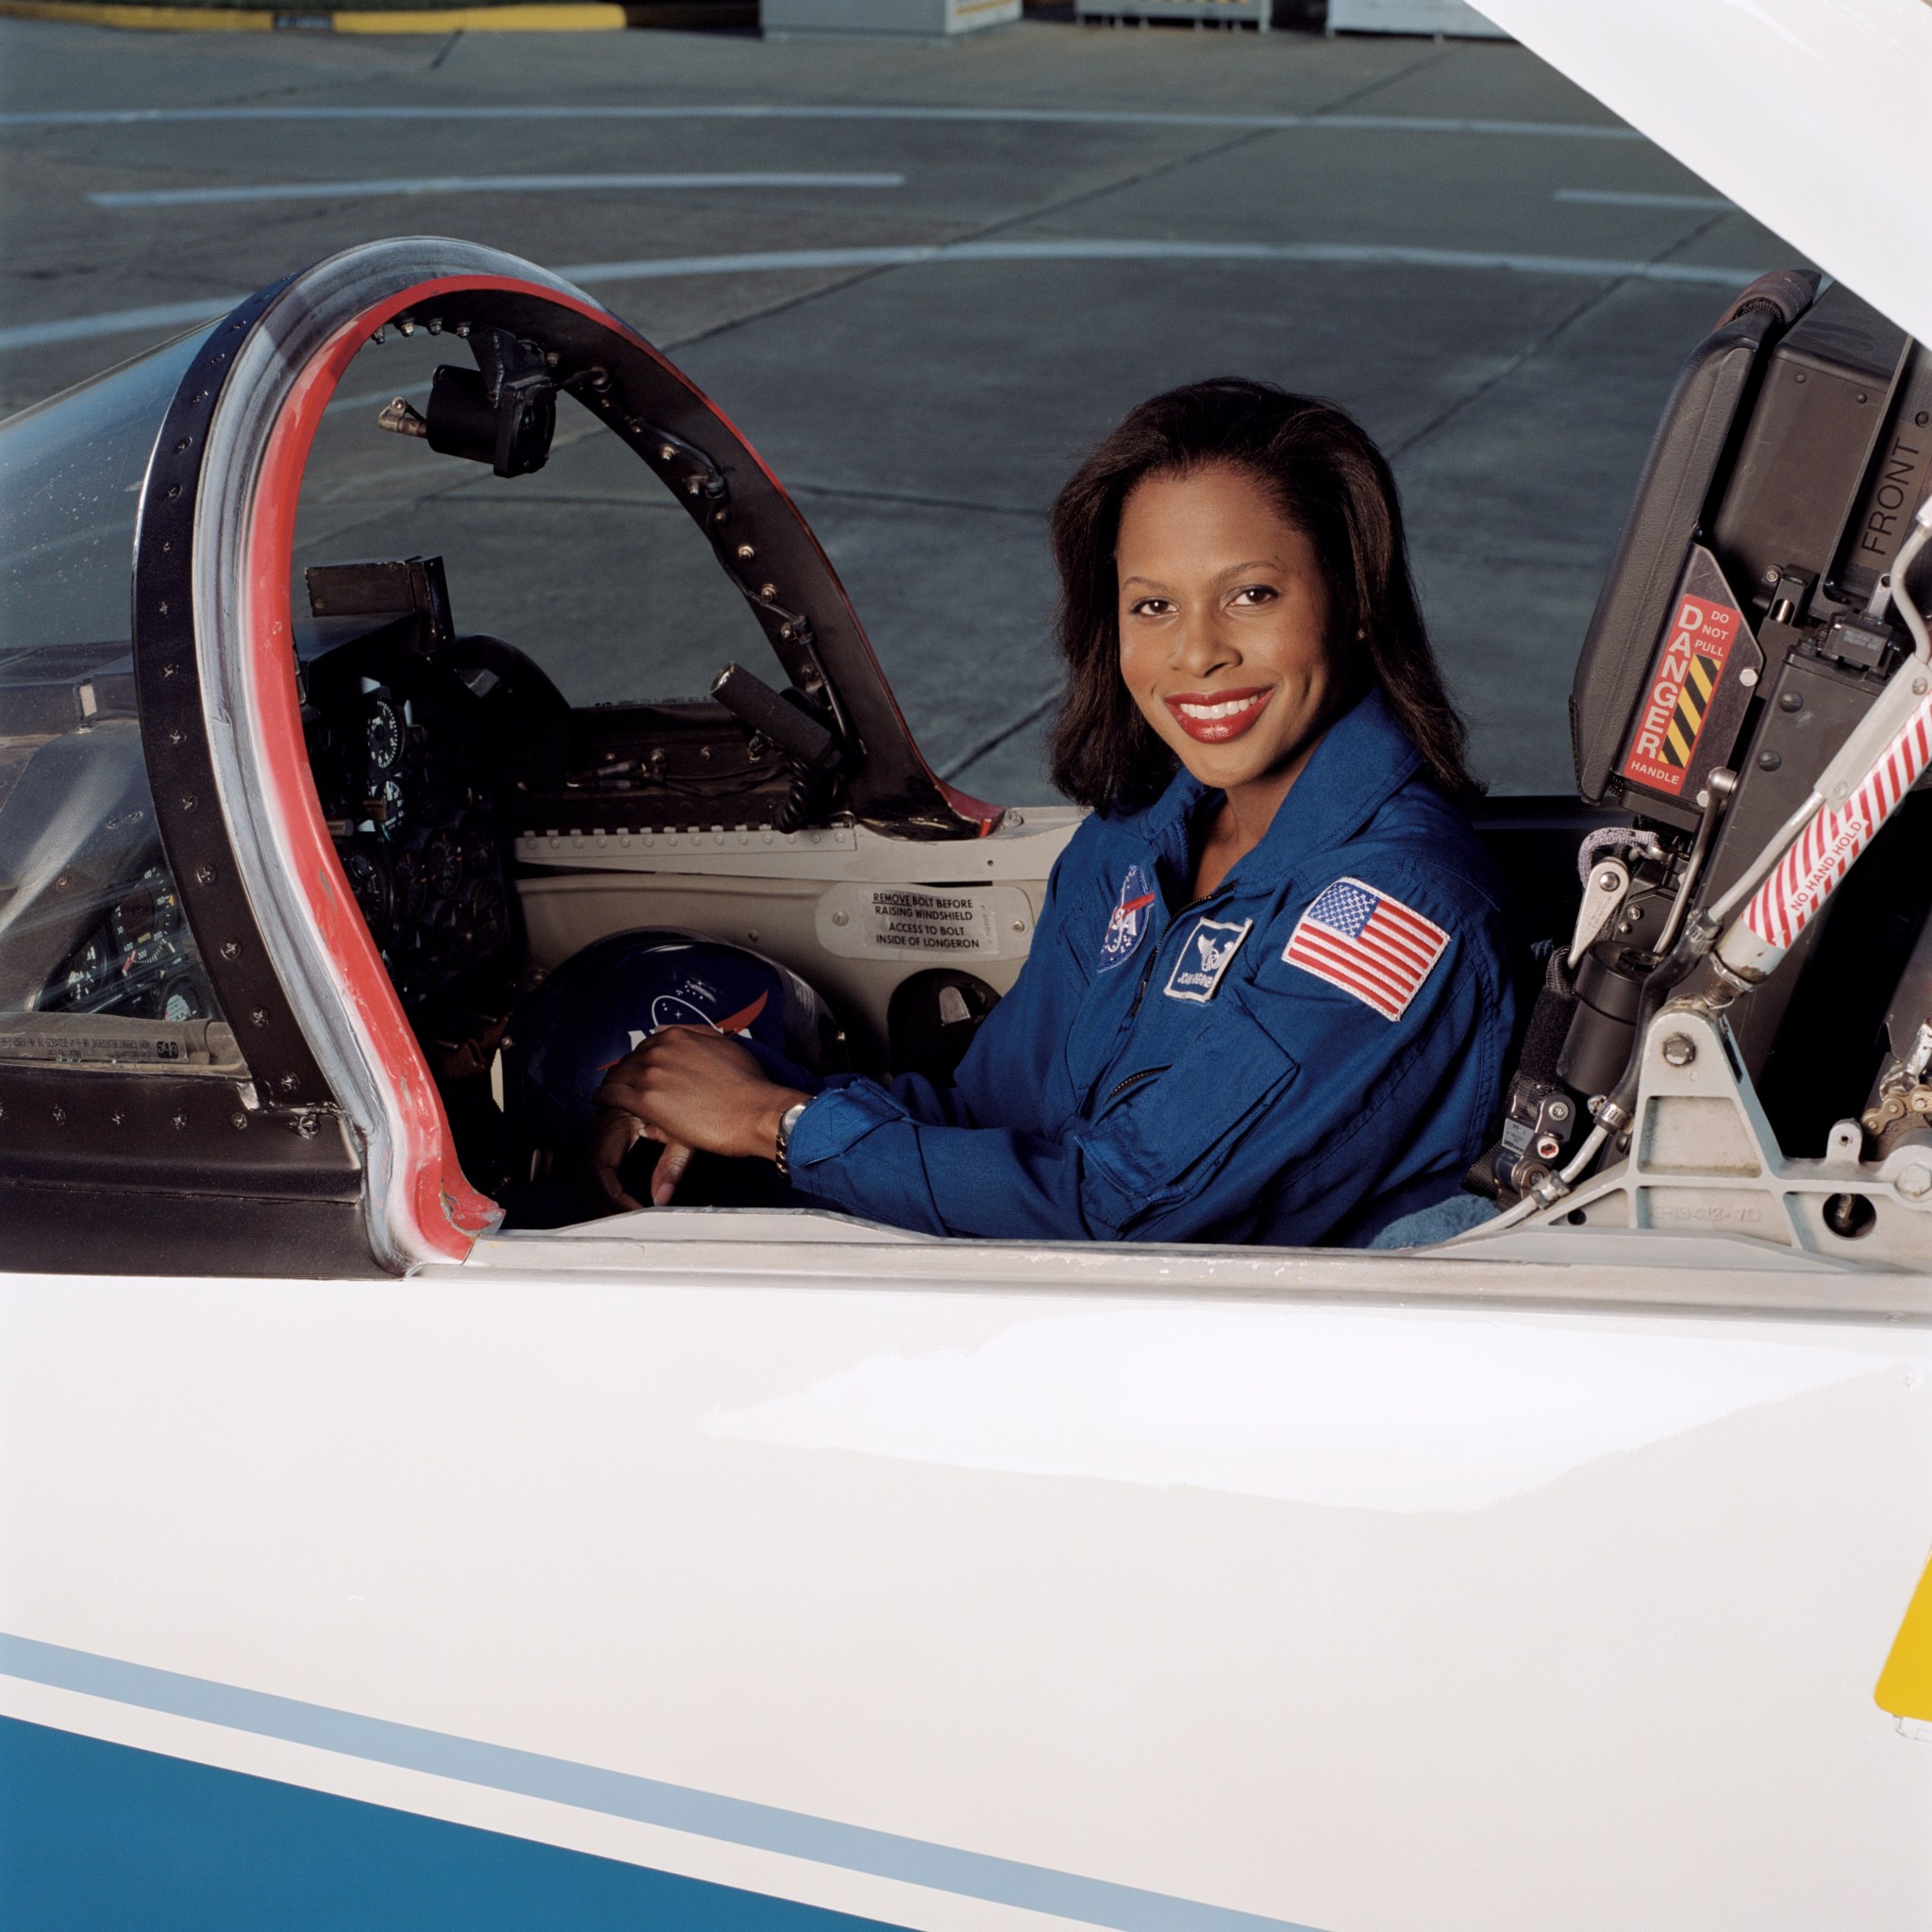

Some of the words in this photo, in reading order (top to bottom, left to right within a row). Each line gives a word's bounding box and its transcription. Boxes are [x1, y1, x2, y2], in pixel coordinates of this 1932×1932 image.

[1861, 437, 1920, 556] FRONT
[1710, 610, 1729, 624] DO
[1702, 625, 1729, 641] NOT
[1693, 640, 1724, 658] PULL
[1636, 604, 1704, 758] DANGER
[1630, 760, 1680, 786] HANDLE
[1790, 892, 1809, 912] NO
[1805, 856, 1836, 894] HAND
[1832, 820, 1863, 857] HOLD
[874, 892, 911, 906] REMOVE
[912, 896, 933, 908] BOLT
[936, 898, 974, 908] BEFORE
[874, 906, 913, 918] RAISING
[914, 908, 974, 921] WINDSHIELD
[889, 923, 924, 934] ACCESS
[925, 924, 938, 935] TO
[940, 925, 965, 936] BOLT
[875, 934, 908, 946] INSIDE
[908, 936, 922, 946] OF
[923, 937, 979, 948] LONGERON
